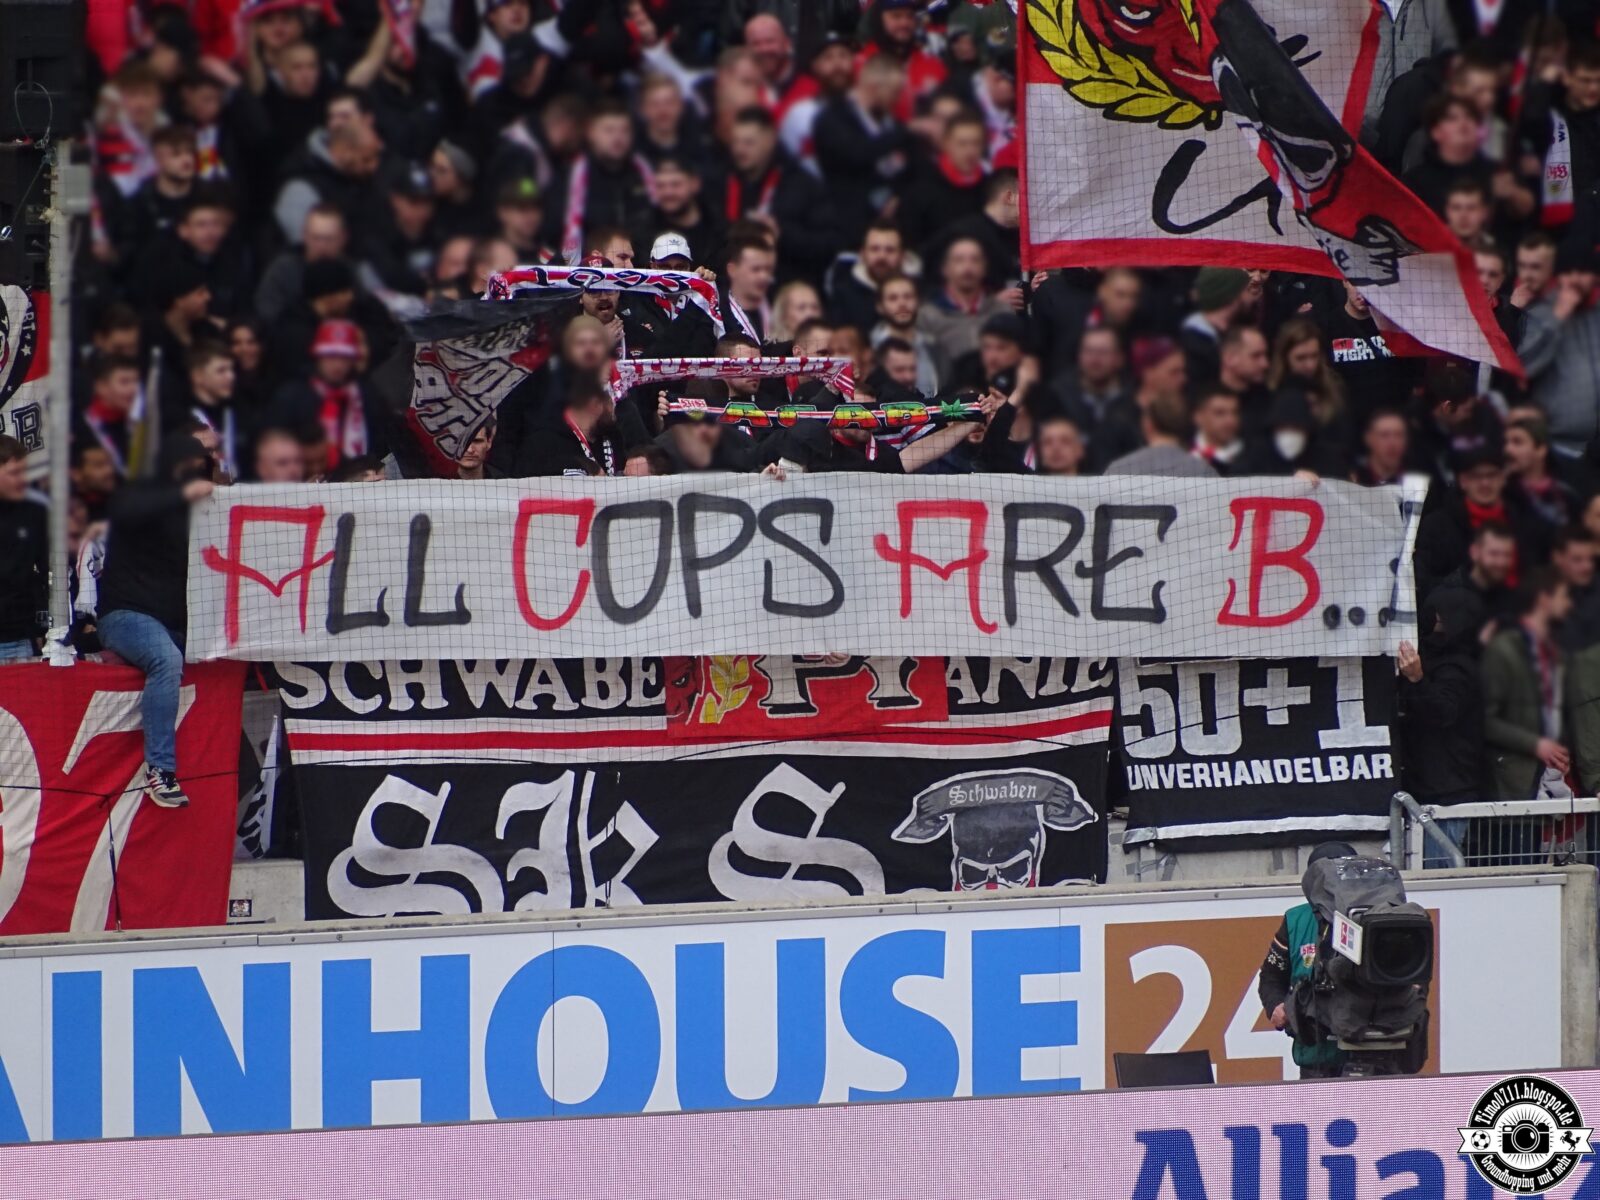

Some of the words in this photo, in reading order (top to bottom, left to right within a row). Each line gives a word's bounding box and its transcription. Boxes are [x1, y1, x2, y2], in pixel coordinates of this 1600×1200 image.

[201, 504, 471, 646] ALL
[513, 492, 844, 632] COPS
[874, 500, 1177, 634] ARE
[1117, 657, 1391, 759] 50+1
[949, 781, 1037, 805] Schwaben
[1127, 753, 1393, 790] UNVERHANDELBAR
